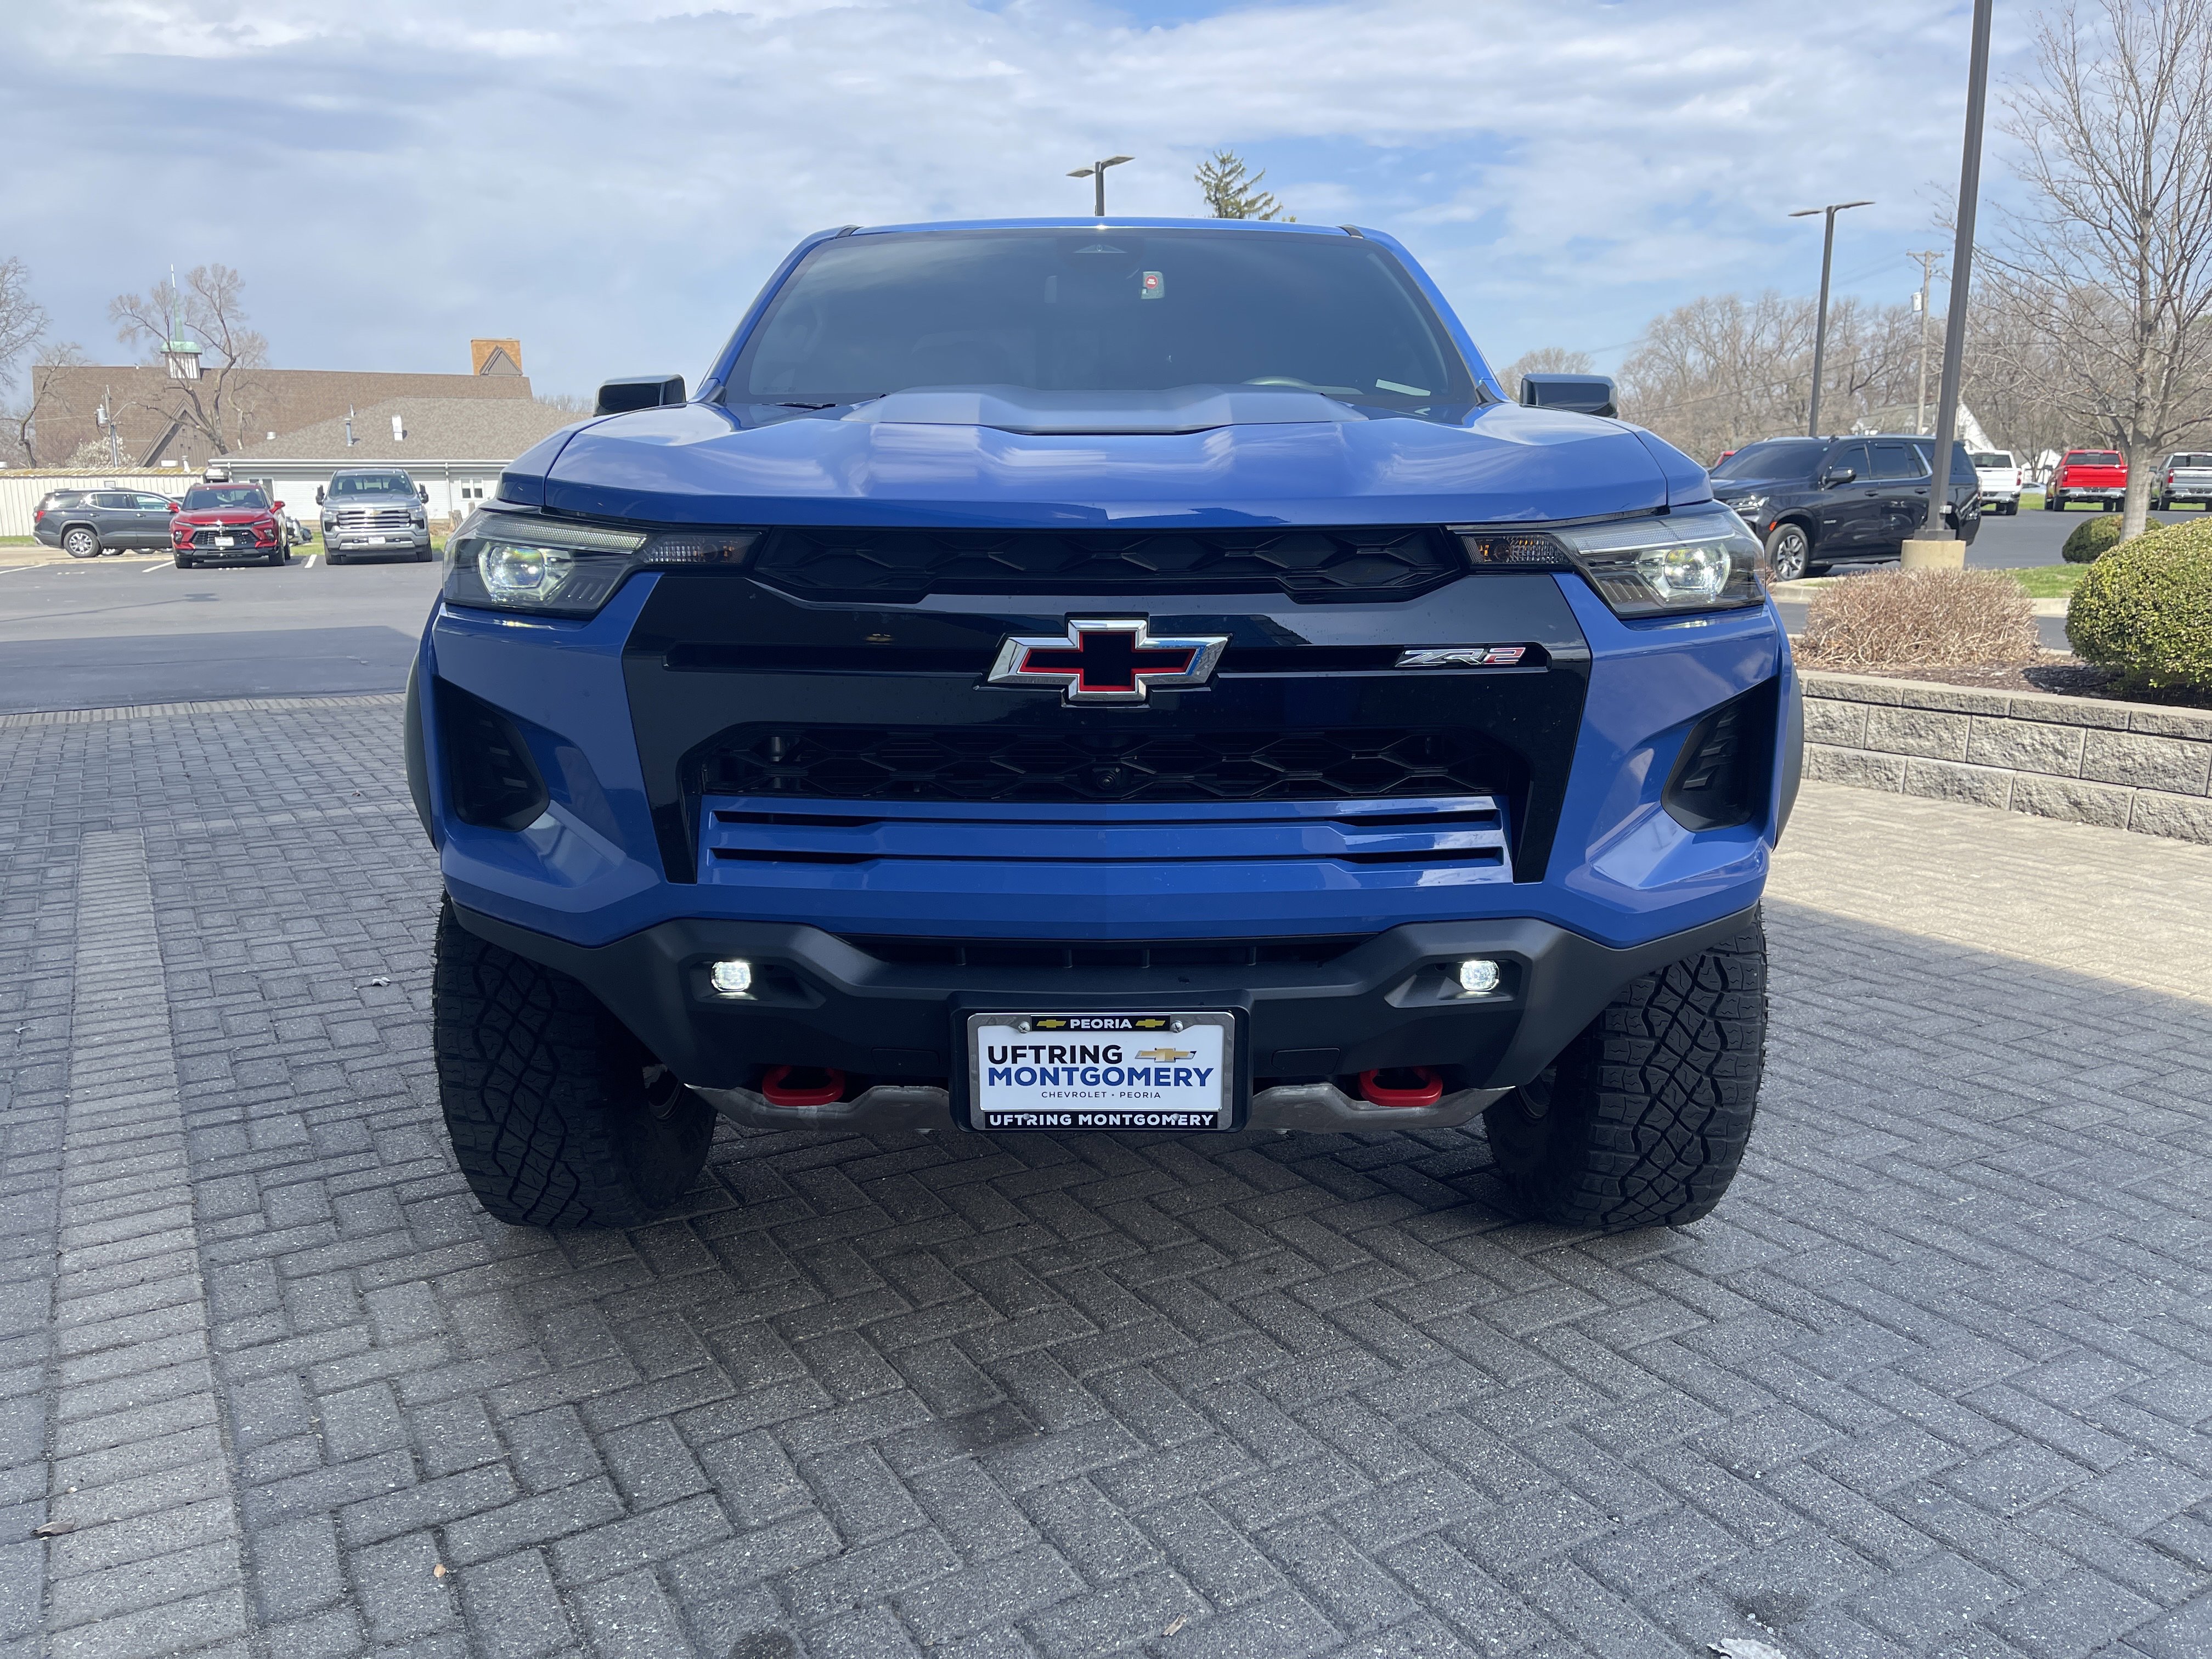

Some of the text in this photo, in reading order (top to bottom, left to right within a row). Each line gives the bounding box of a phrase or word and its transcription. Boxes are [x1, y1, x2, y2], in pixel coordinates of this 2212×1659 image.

[1395, 647, 1526, 668] ZR2
[1070, 1018, 1132, 1029] PEORIA
[988, 1045, 1122, 1065] UFTRING
[988, 1066, 1214, 1087] MONTGOMERY
[989, 1114, 1214, 1126] UFTRING MONTGOMERY
